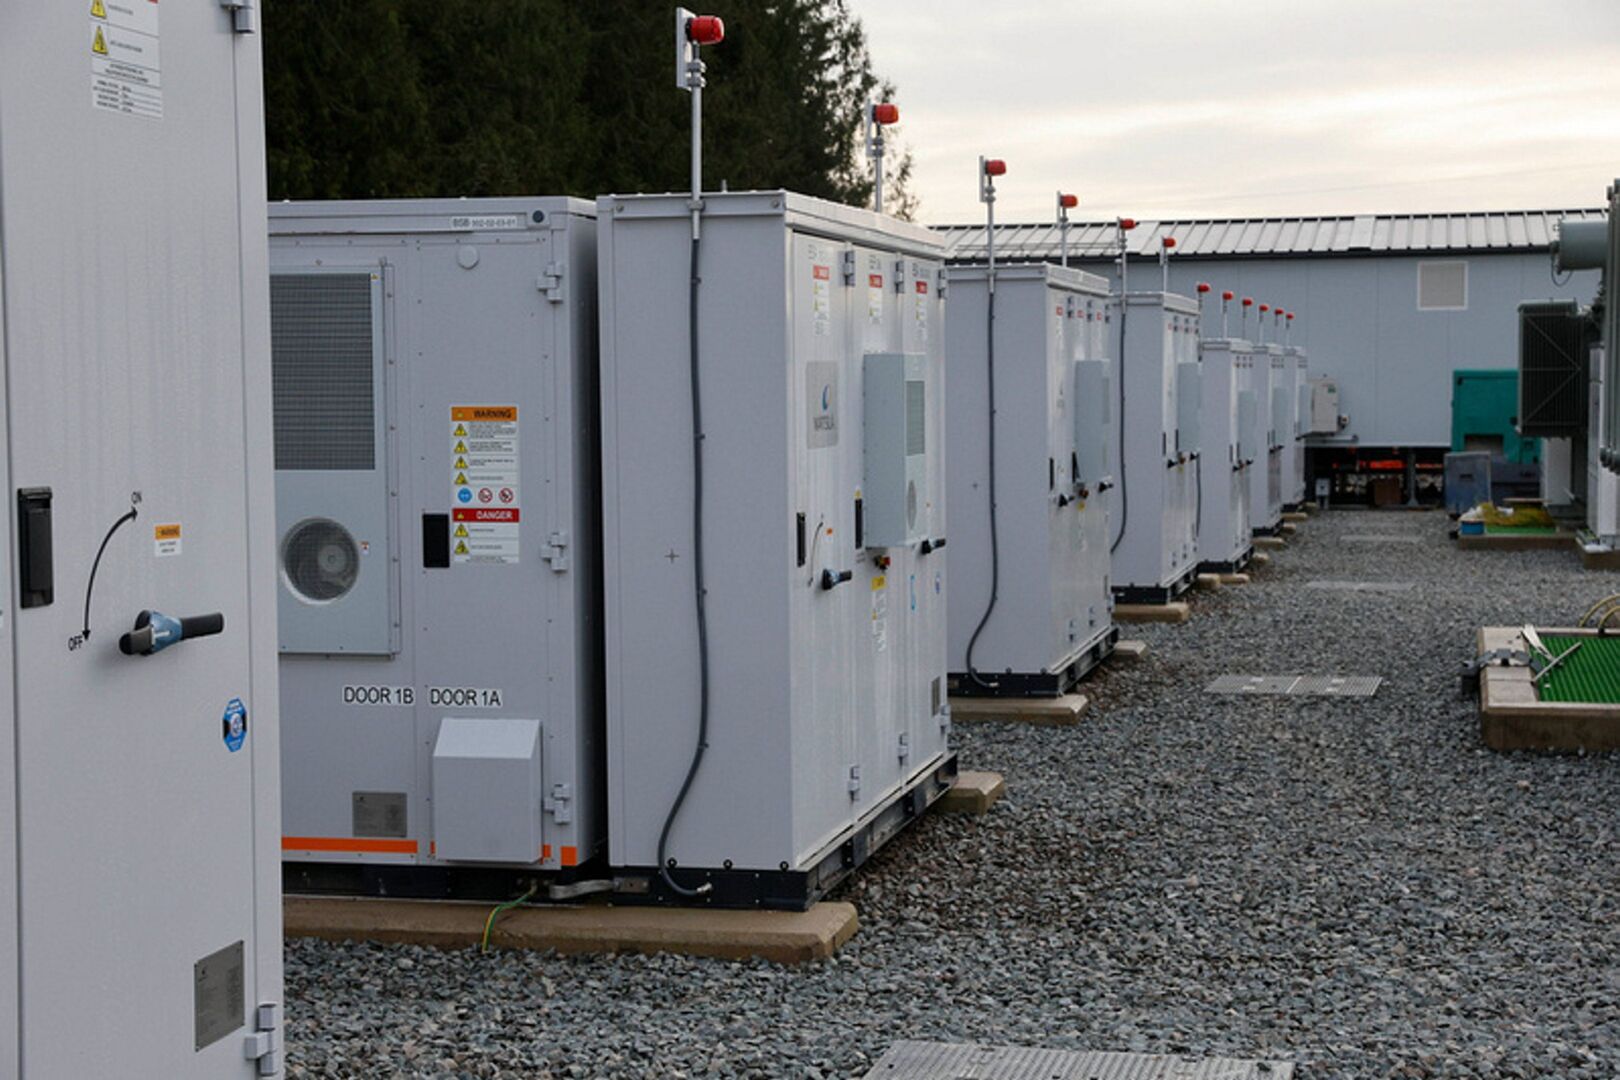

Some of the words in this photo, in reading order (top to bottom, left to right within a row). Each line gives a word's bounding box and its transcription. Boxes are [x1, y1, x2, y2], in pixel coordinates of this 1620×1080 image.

[474, 410, 512, 419] WARNING
[131, 491, 143, 505] ON
[476, 510, 513, 520] DANGER
[68, 635, 83, 651] OFF
[344, 686, 391, 704] DOOR
[396, 687, 414, 704] 1B
[430, 688, 477, 706] DOOR
[482, 689, 501, 707] 1A
